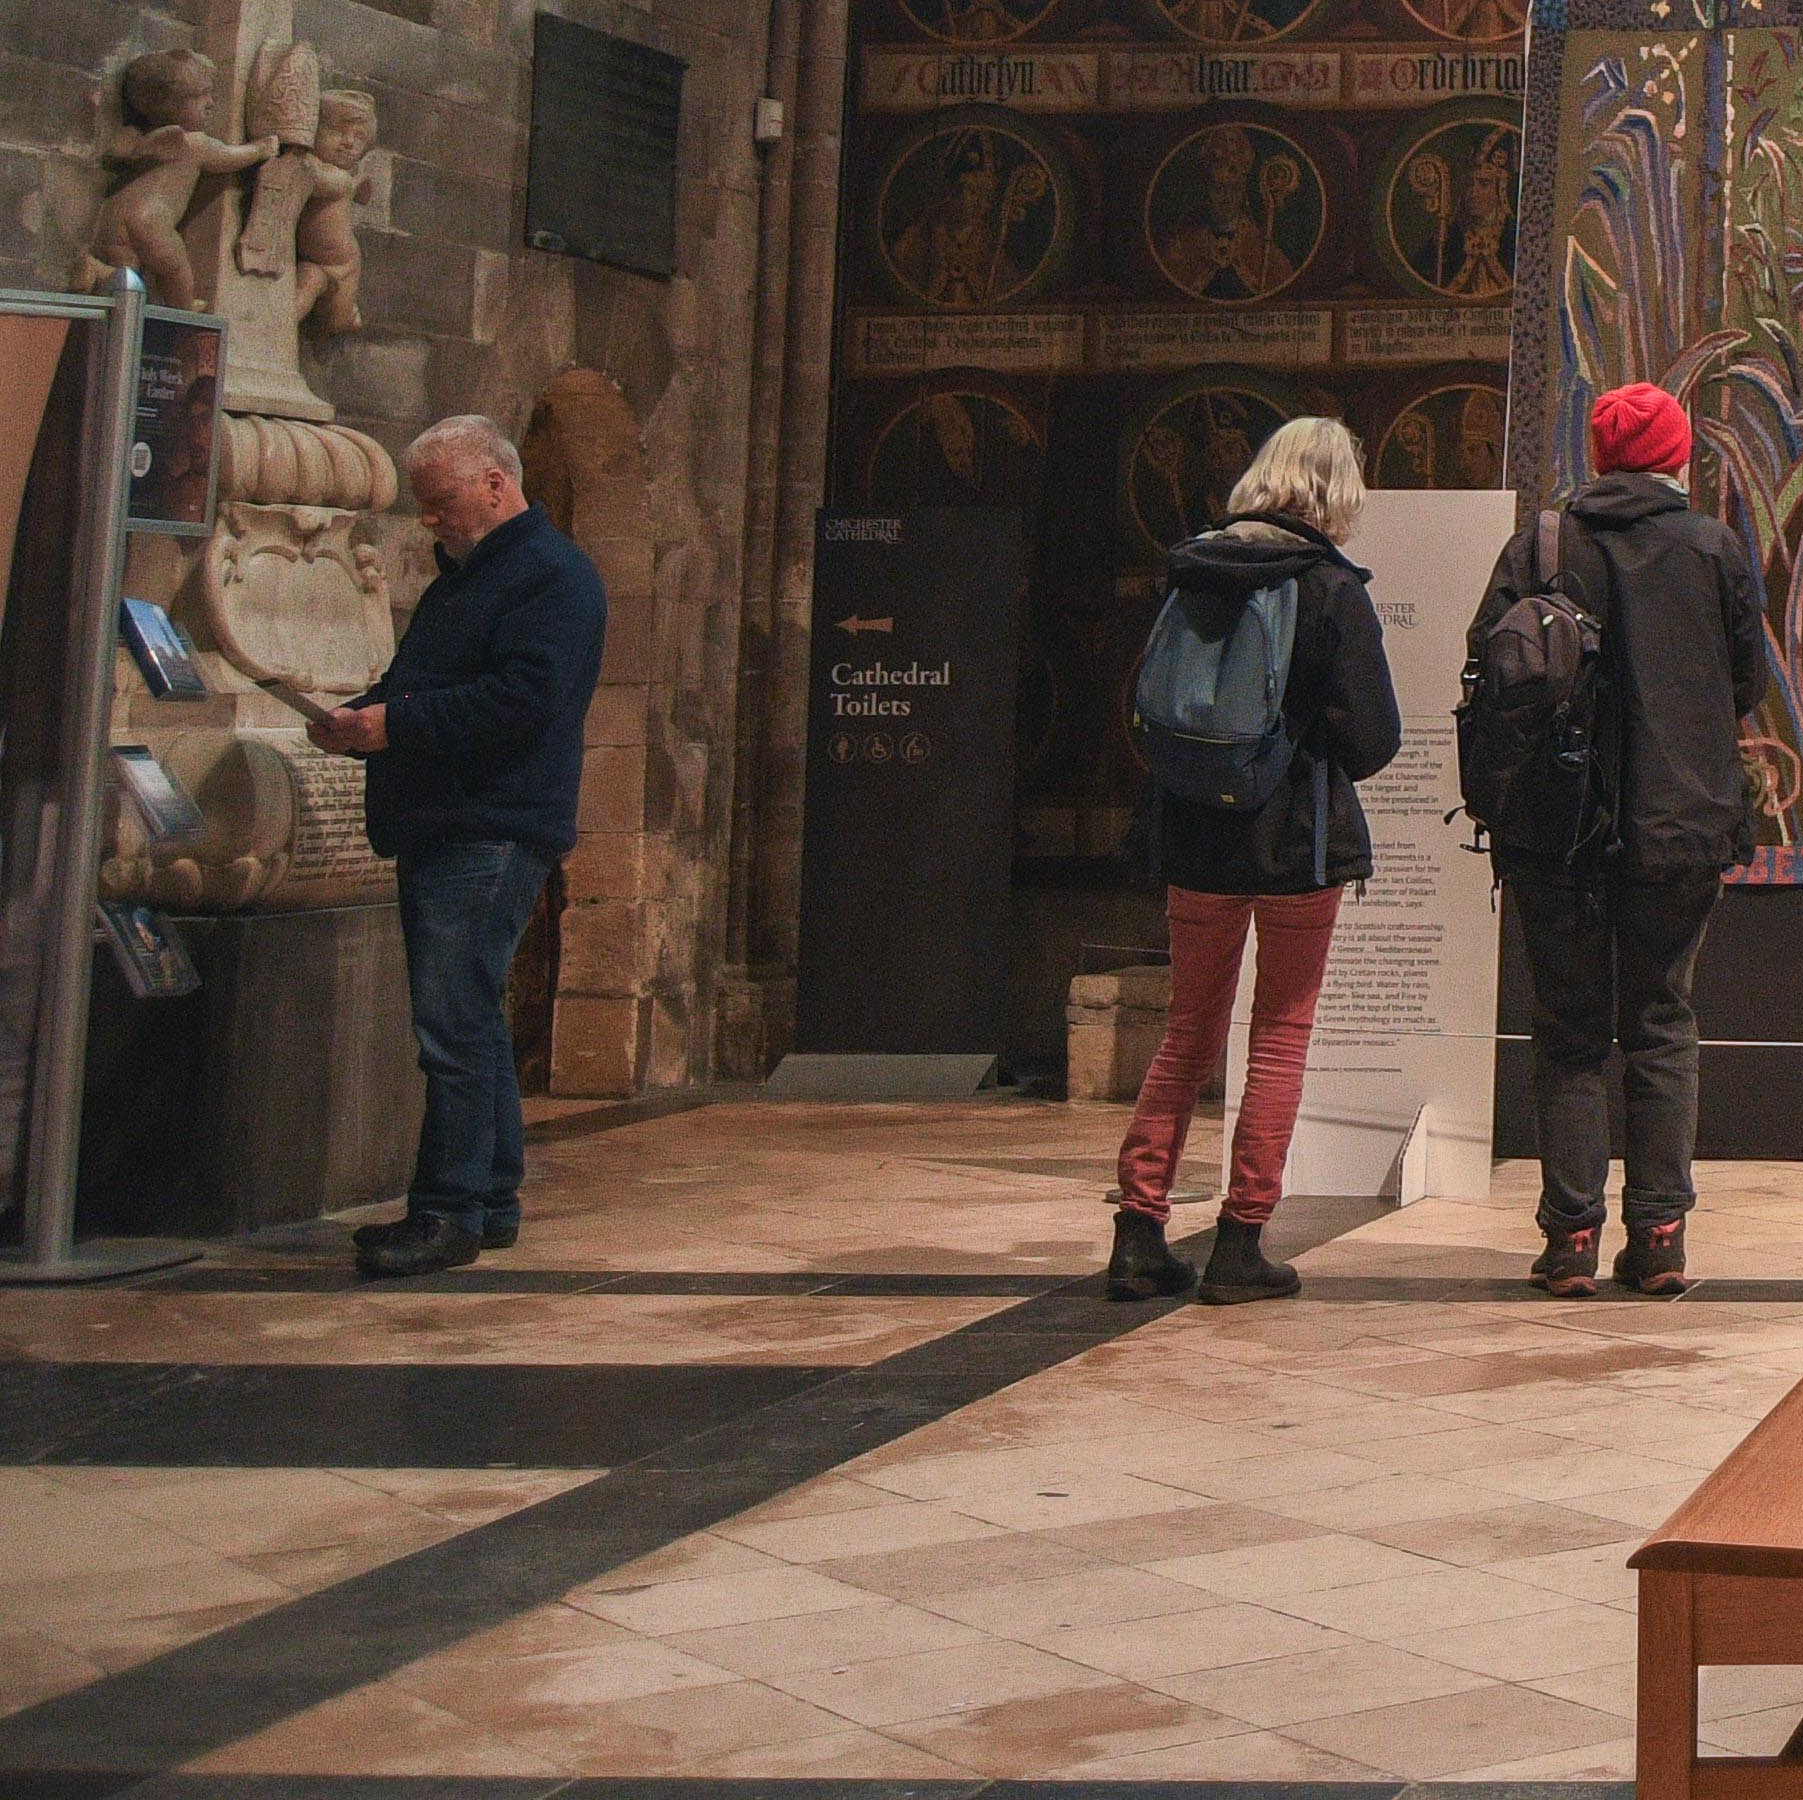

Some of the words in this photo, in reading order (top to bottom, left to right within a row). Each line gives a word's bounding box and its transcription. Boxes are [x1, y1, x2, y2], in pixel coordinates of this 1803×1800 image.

[825, 518, 902, 531] CHICHESTER
[825, 529, 904, 544] CATHEDRAL
[831, 661, 951, 686] Cathedral
[830, 691, 912, 717] Toilets
